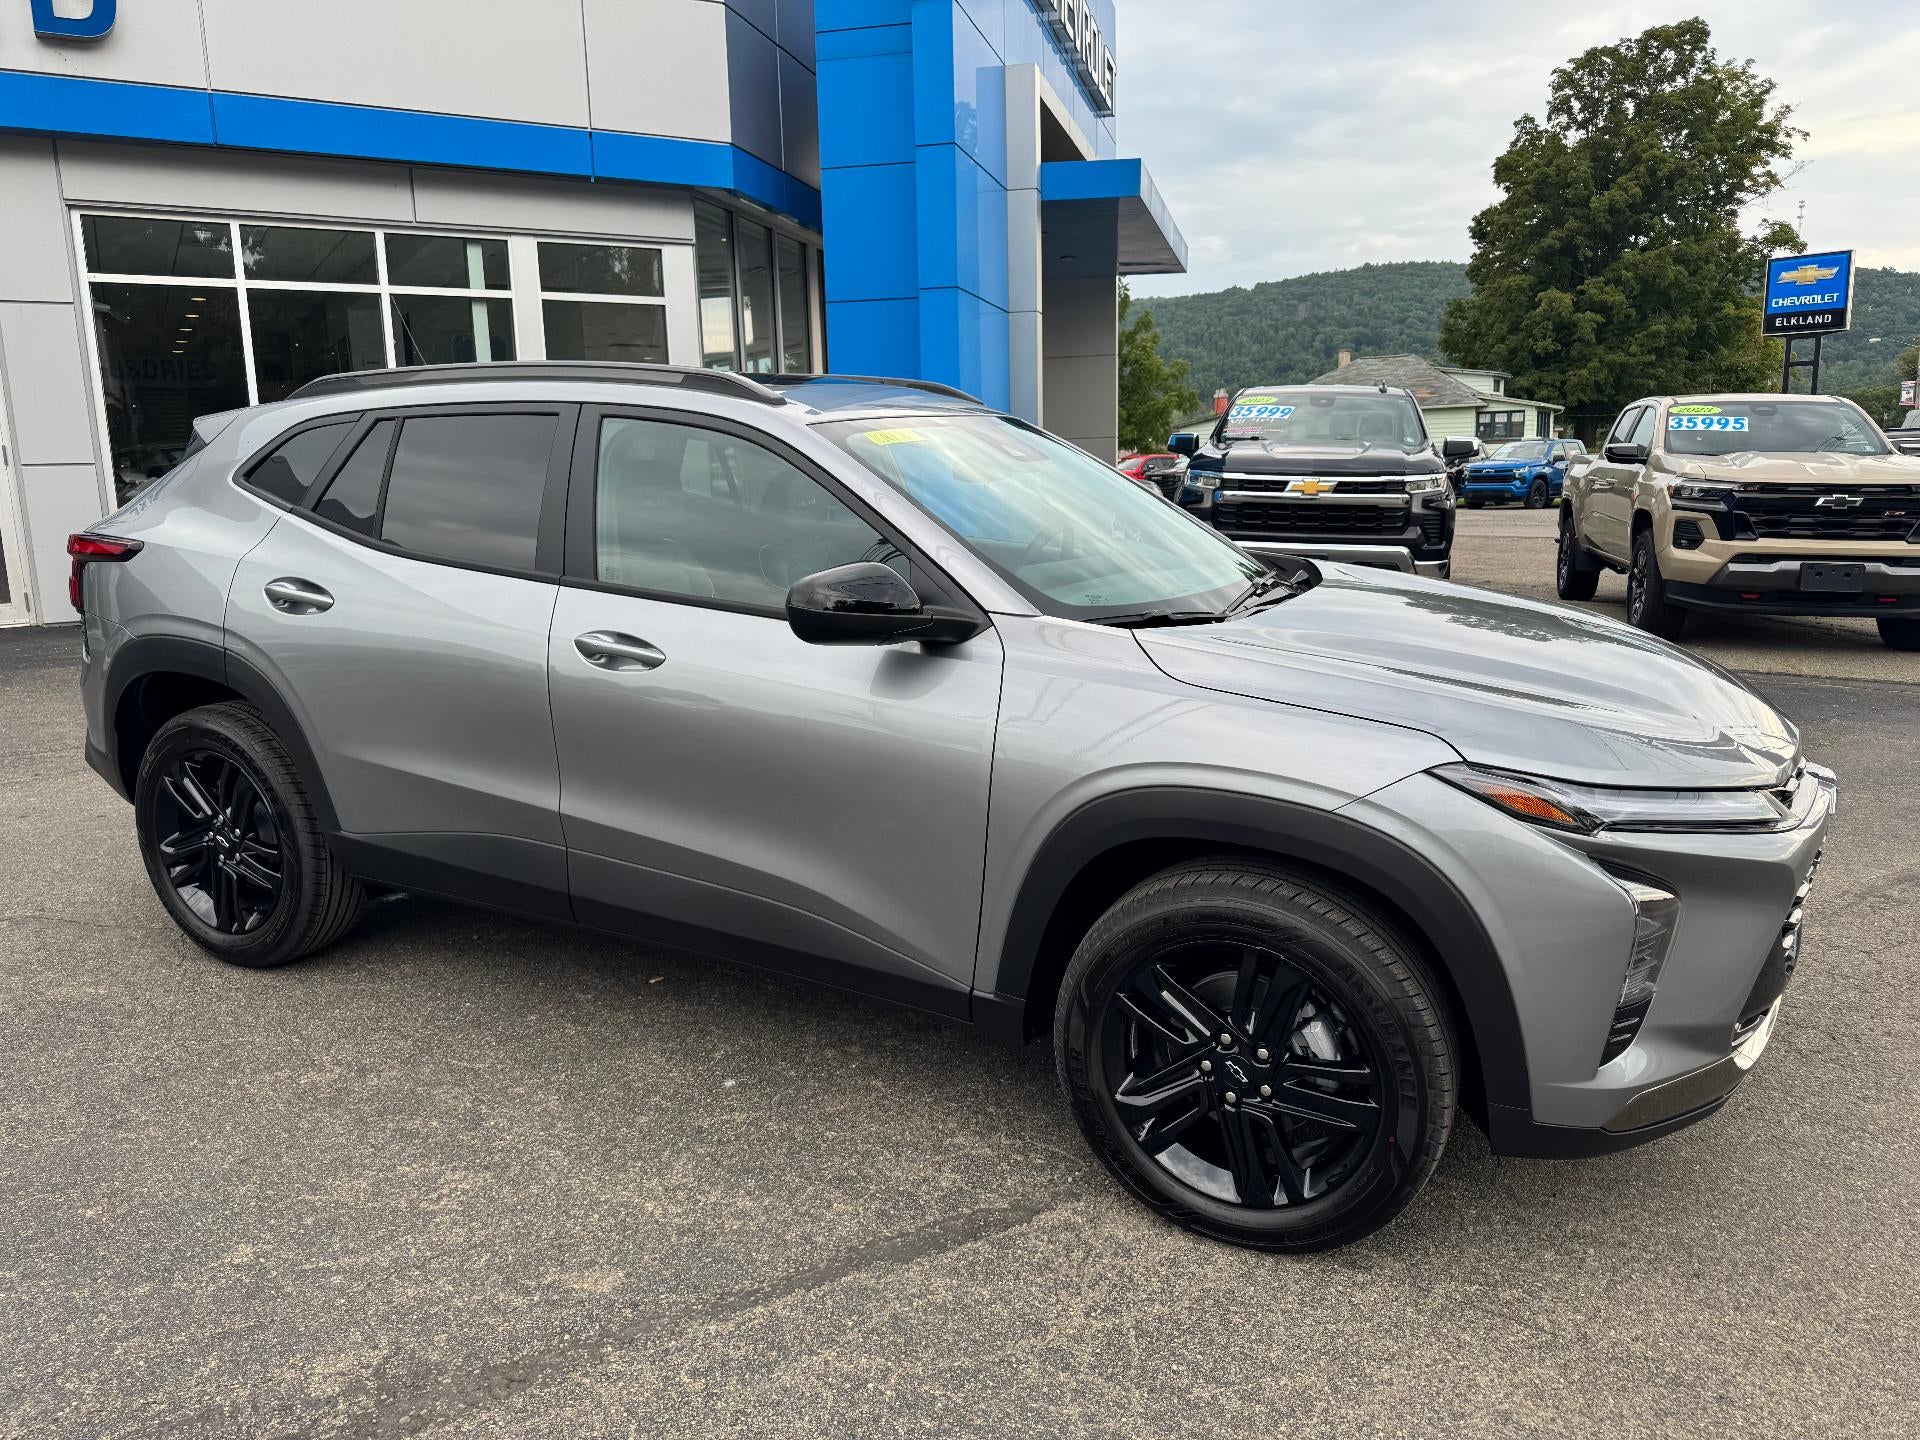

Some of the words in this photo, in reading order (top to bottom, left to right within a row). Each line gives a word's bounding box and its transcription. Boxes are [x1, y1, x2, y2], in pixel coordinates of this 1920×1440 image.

[1049, 0, 1117, 116] EVROLET
[1771, 293, 1840, 308] CHEVROLET
[1775, 314, 1832, 327] ELKLAND
[1230, 406, 1293, 418] 35999
[1669, 416, 1746, 431] 35995
